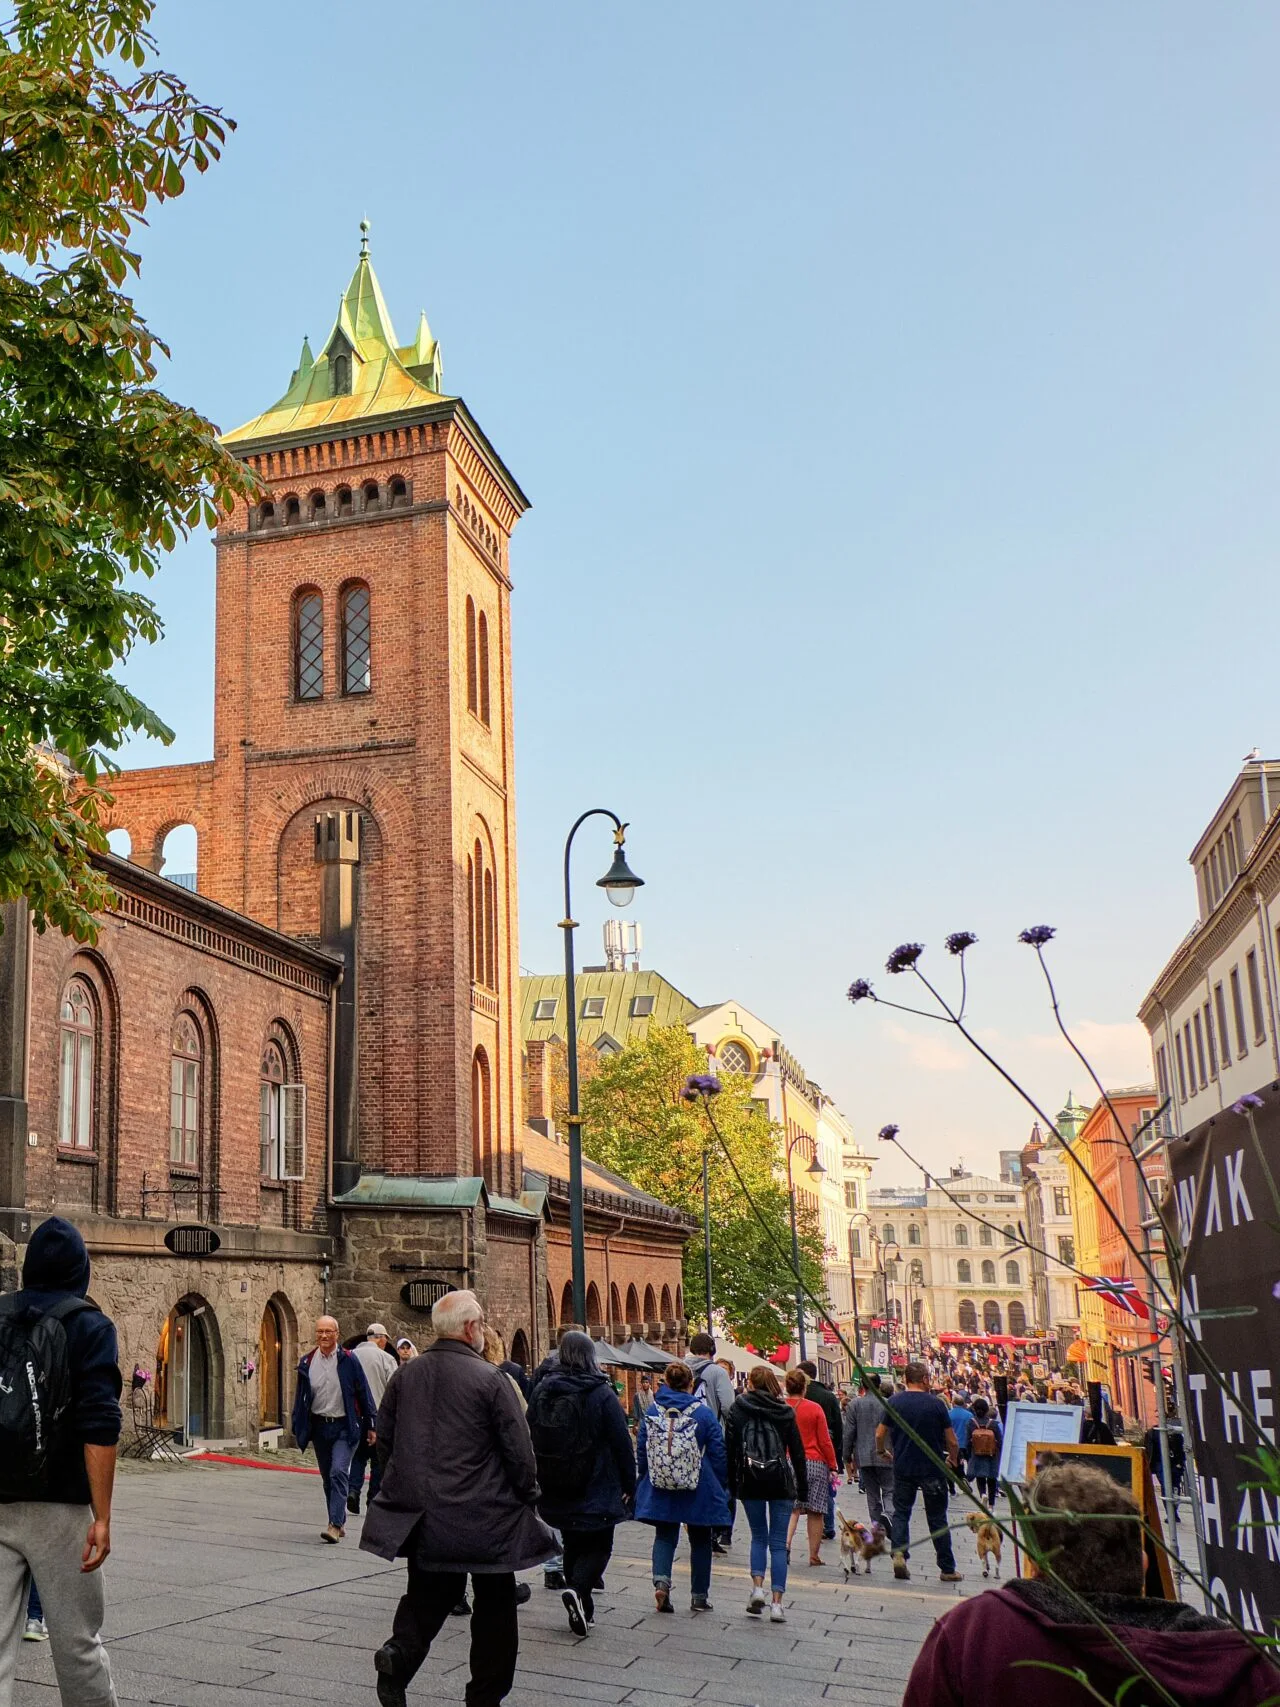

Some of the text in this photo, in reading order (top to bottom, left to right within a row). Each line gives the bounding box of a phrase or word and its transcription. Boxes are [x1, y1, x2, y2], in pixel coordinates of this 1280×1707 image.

[174, 1230, 212, 1253] AMBIENTE
[25, 1361, 39, 1401] UNDER
[1188, 1369, 1276, 1446] THE
